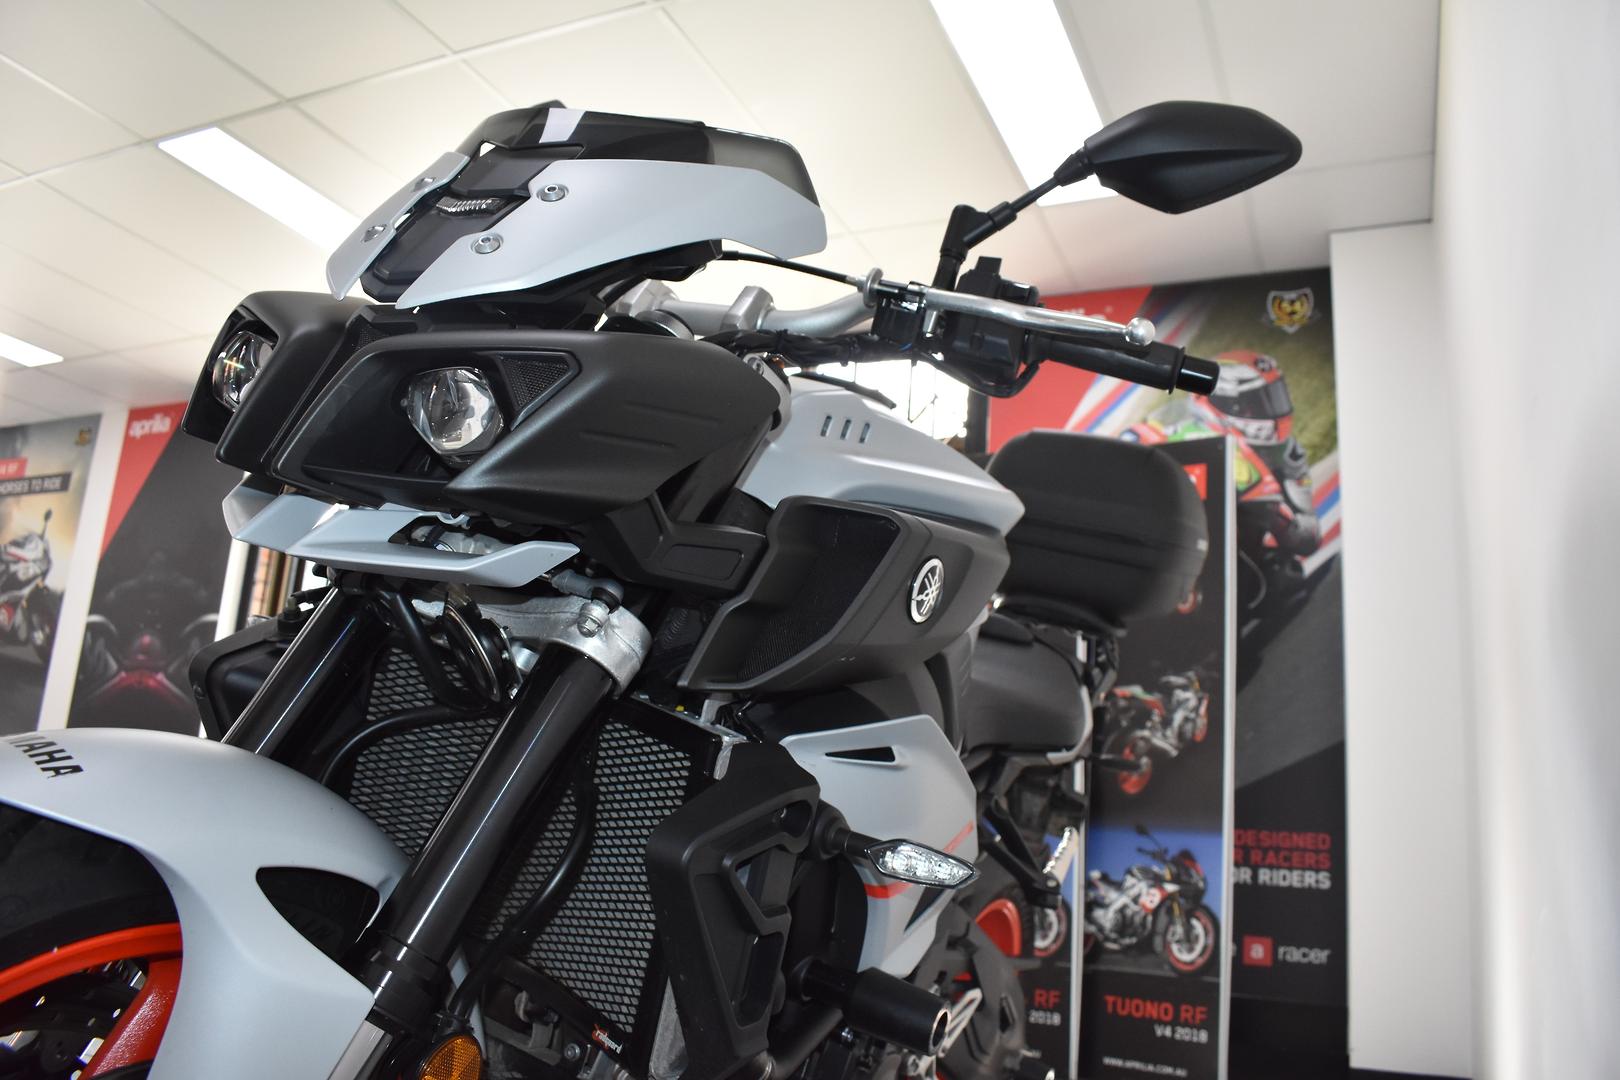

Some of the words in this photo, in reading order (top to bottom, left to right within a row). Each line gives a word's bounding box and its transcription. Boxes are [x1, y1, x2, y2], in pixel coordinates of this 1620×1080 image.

[129, 413, 171, 439] aprilia
[1233, 829, 1331, 850] DESIGNED
[1250, 848, 1331, 869] RACERS
[1258, 867, 1331, 890] RIDERS
[1278, 945, 1330, 964] racer
[1034, 988, 1061, 1009] RF
[1029, 1009, 1061, 1026] 2018
[1104, 995, 1174, 1022] TUONO
[1180, 1003, 1208, 1024] RF
[1153, 1023, 1172, 1037] V4
[1174, 1026, 1209, 1044] 2018
